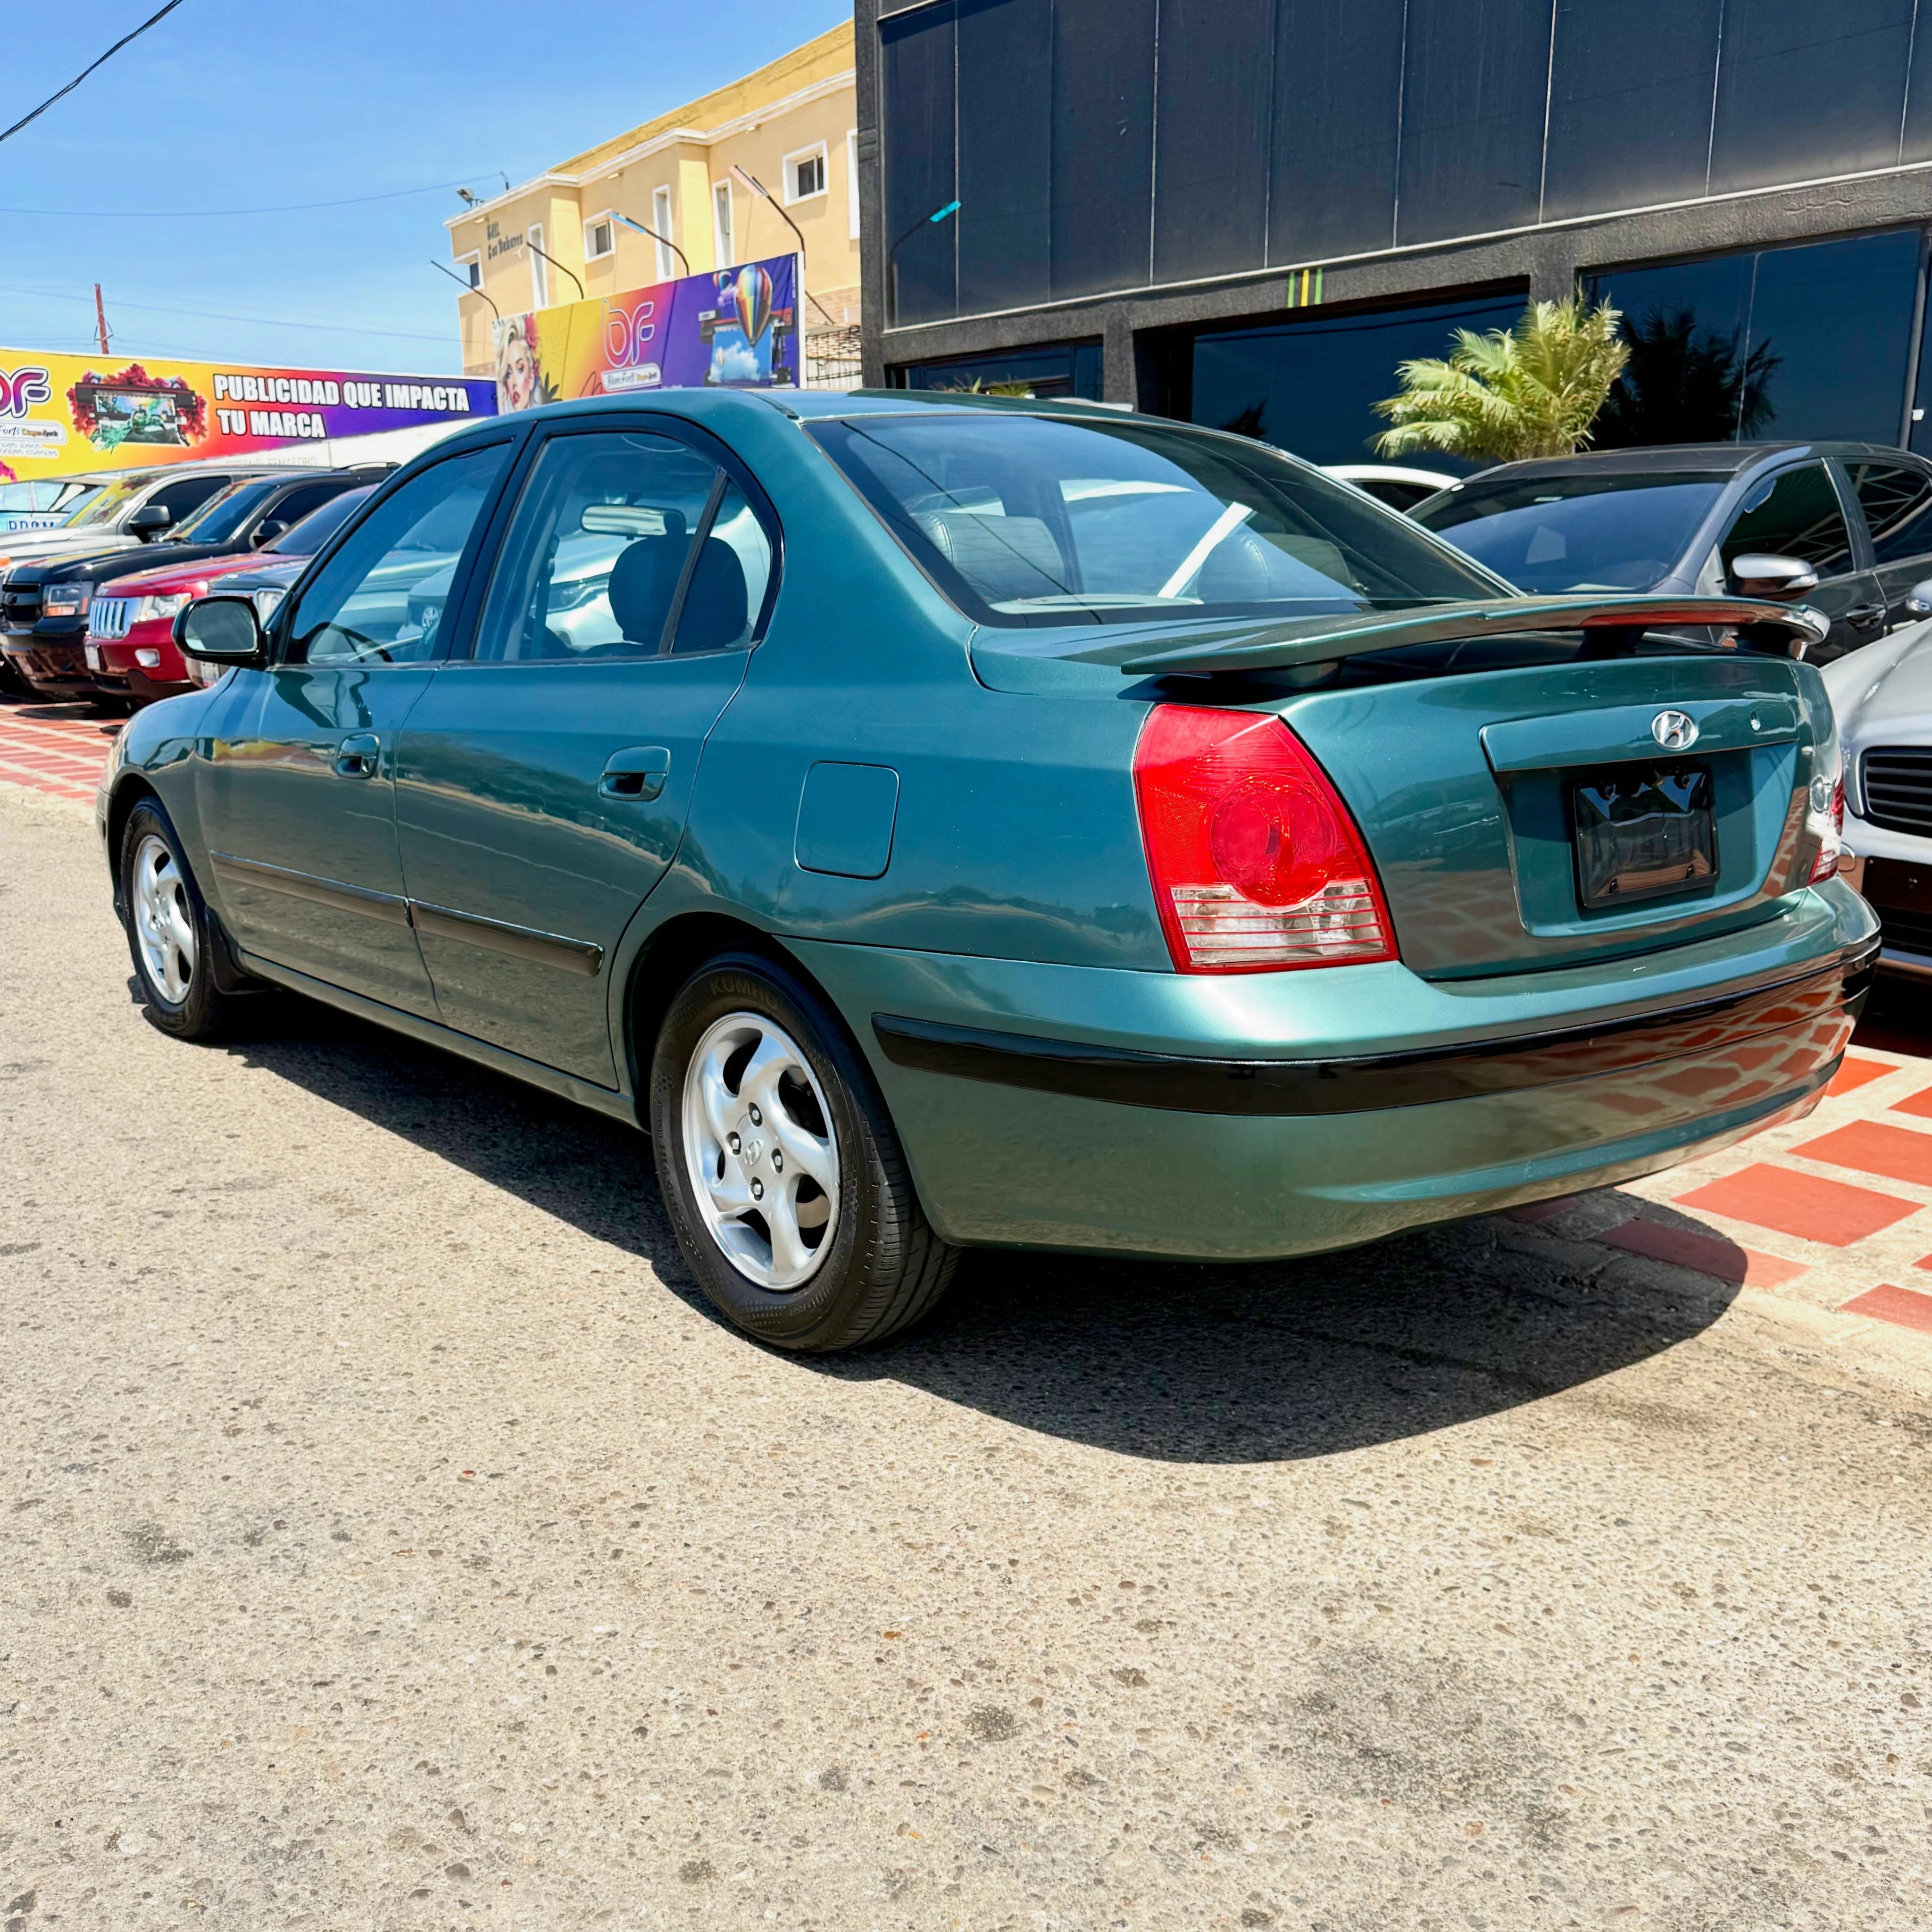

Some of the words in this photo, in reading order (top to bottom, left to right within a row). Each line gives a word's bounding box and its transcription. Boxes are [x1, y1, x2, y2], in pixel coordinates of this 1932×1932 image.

[213, 374, 340, 406] PUBLICIDAD
[343, 381, 383, 410] QUE
[384, 383, 471, 412] IMPACTA
[216, 408, 247, 436] TU
[249, 410, 327, 439] MARCA
[709, 976, 779, 1011] KUMHO
